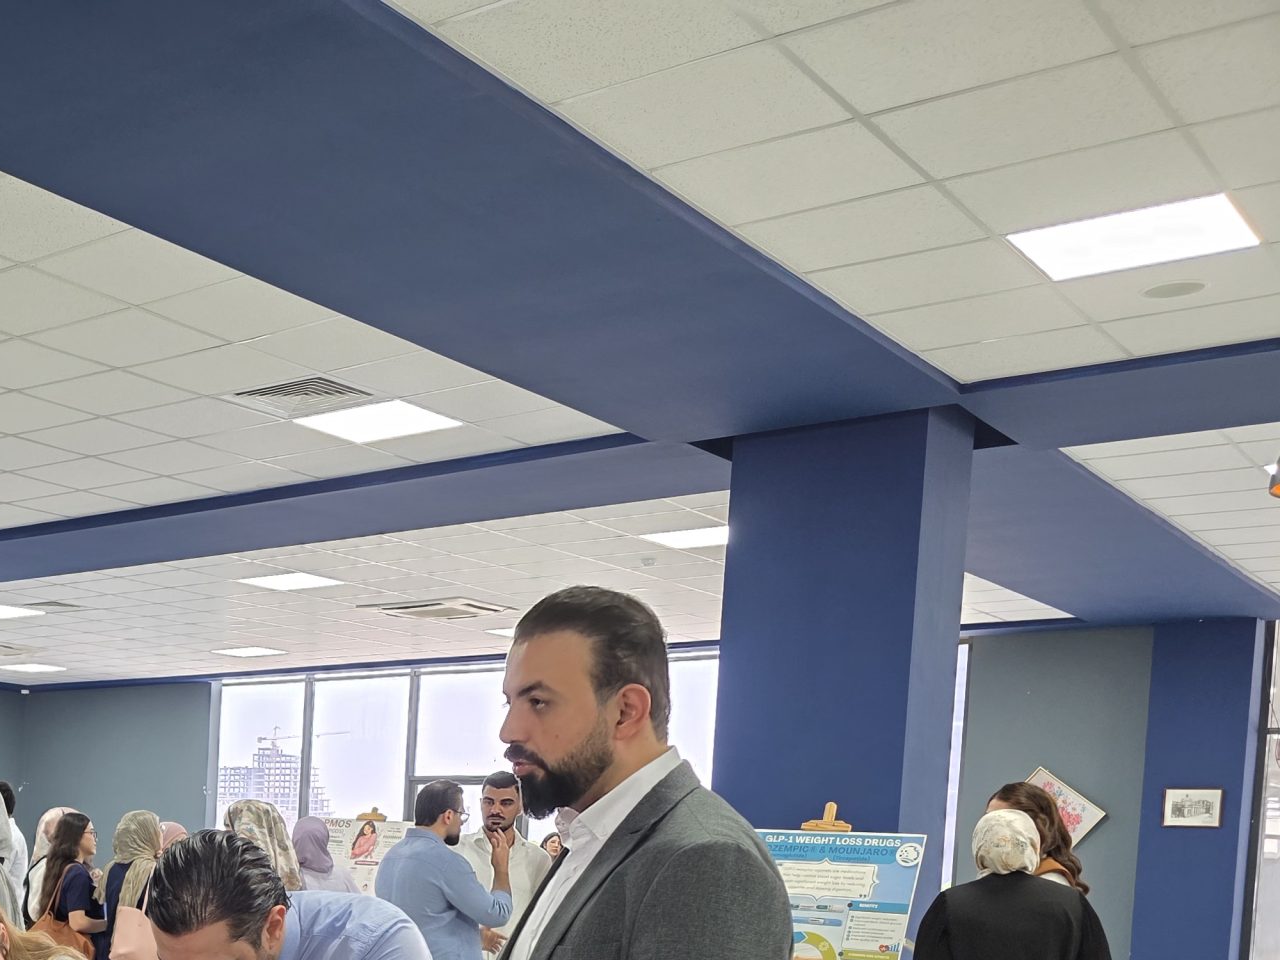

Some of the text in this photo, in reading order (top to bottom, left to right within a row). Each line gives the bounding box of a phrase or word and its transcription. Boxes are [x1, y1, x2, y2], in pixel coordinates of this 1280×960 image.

[765, 835, 902, 848] GLP-1 WEIGHT LOSS DRUGS
[819, 845, 826, 854] &
[828, 846, 888, 856] MOUNJARO
